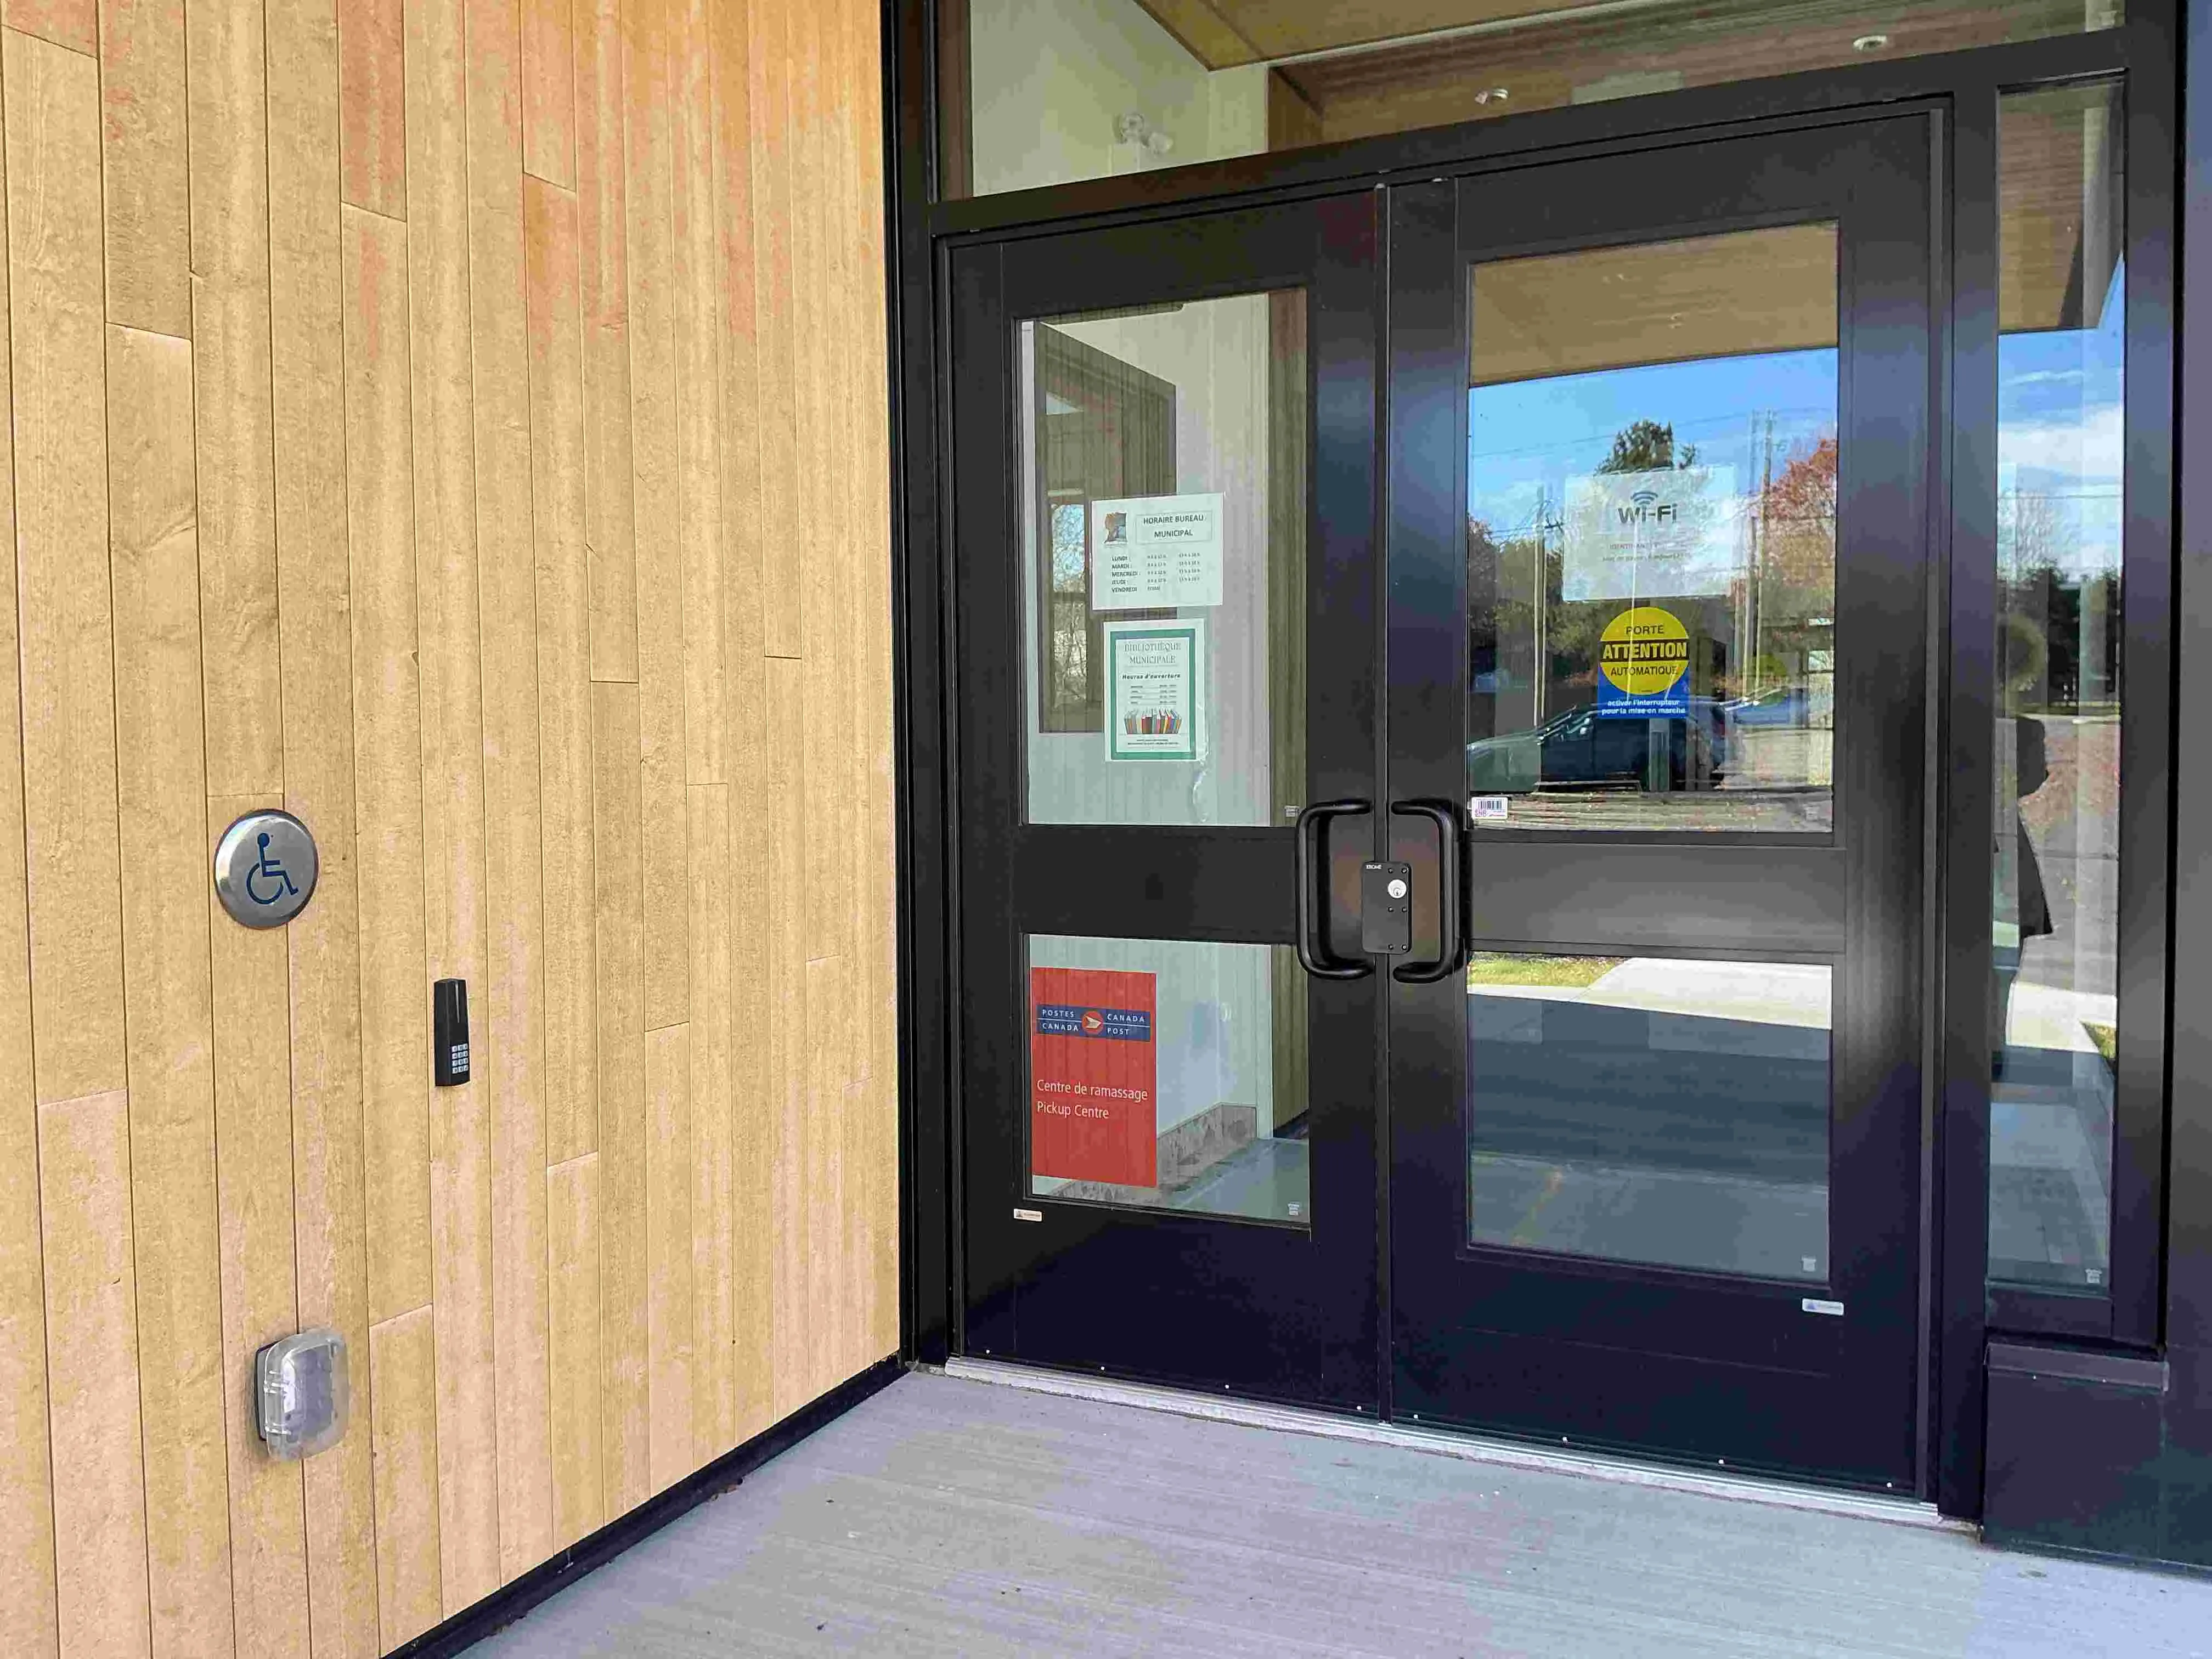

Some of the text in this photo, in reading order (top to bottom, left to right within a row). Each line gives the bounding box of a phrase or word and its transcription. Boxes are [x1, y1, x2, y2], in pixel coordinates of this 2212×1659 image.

[1618, 503, 1678, 524] Wi-Fi
[1143, 514, 1204, 524] HORAIRE BUREAU
[1154, 529, 1193, 538] MUNICIPAL
[1626, 625, 1664, 635] PORTE
[1602, 642, 1687, 659] ATTENTION
[1129, 655, 1176, 664] MUNICIPALE
[1610, 666, 1679, 676] AUTOMATIQUE
[1607, 698, 1632, 707] activer
[1042, 1009, 1074, 1018] POSTES
[1106, 1013, 1146, 1023] CANADA
[1042, 1023, 1079, 1032] CANADA
[1107, 1027, 1130, 1036] POST
[1037, 1079, 1148, 1103] Centre de ramassage
[1037, 1101, 1109, 1119] Pickup Centre
